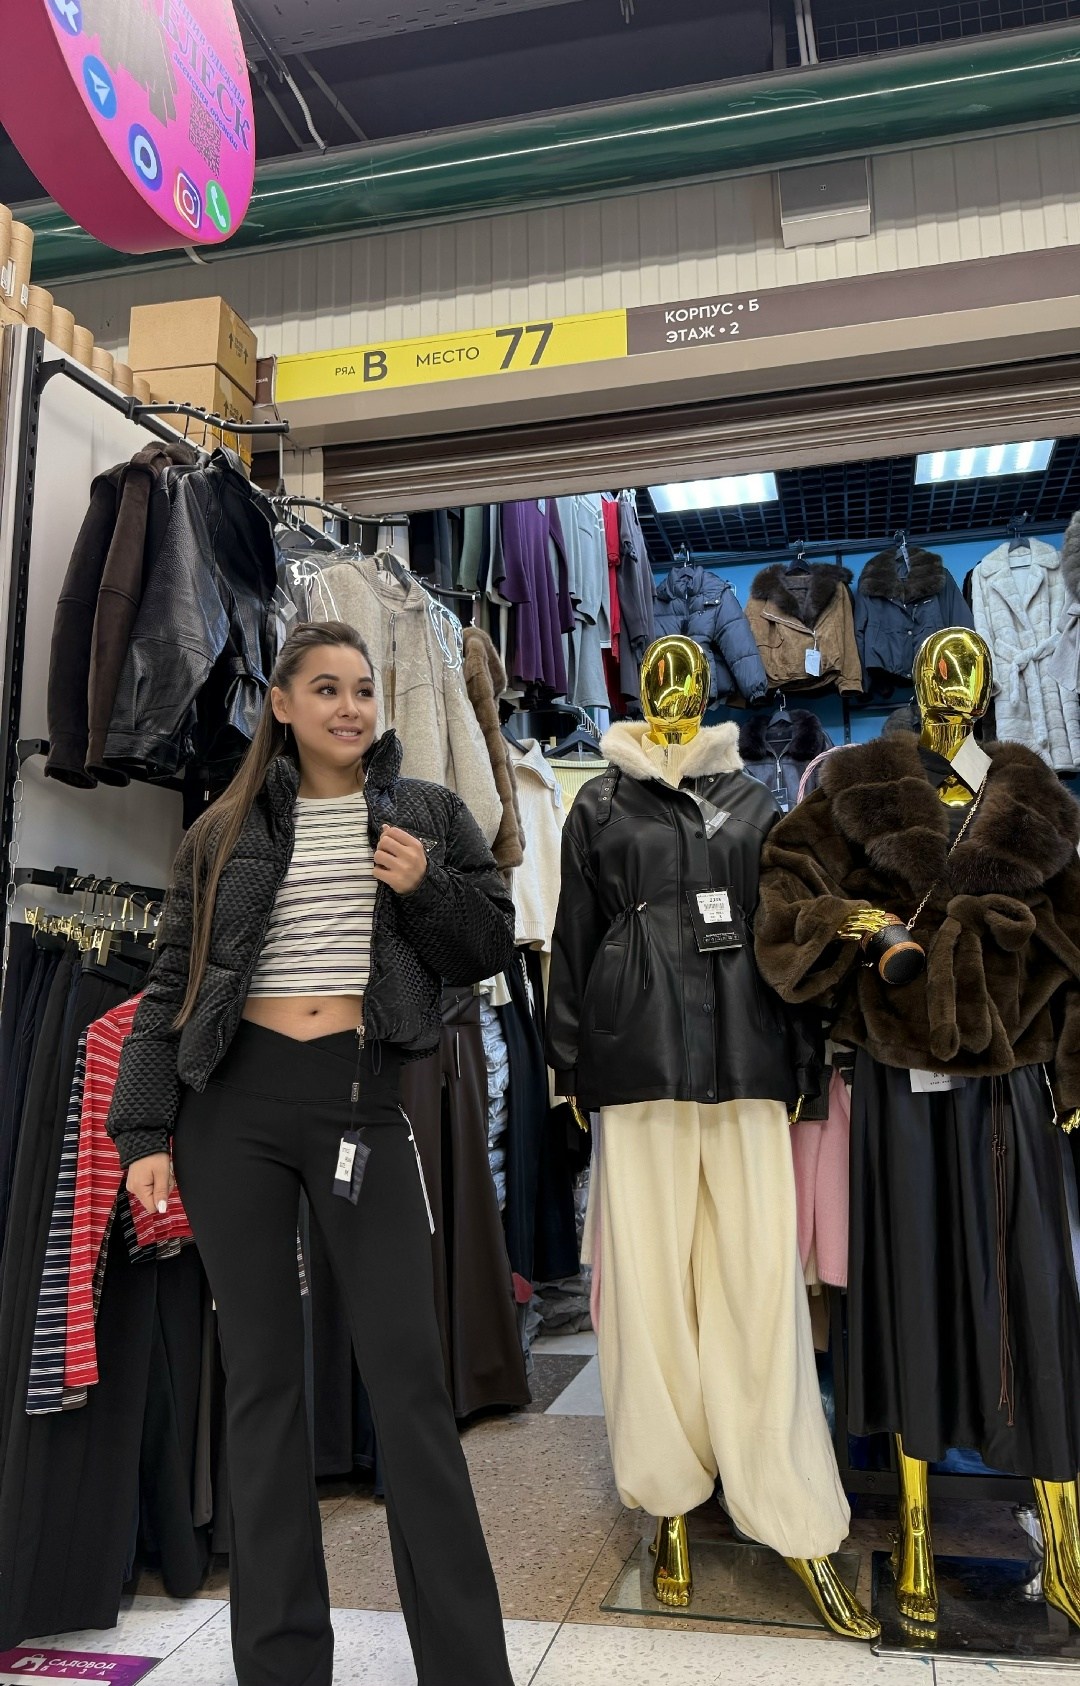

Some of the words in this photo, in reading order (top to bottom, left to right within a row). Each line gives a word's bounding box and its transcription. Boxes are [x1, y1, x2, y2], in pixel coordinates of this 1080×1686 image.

[160, 0, 250, 151] БЛЕСК
[664, 302, 734, 324] КОРПУС
[748, 298, 760, 312] Б
[665, 324, 716, 343] ЭТАЖ
[729, 321, 740, 335] 2
[335, 366, 356, 376] РЯД
[363, 350, 388, 383] В
[416, 346, 480, 367] МЕСТО
[495, 322, 554, 371] 77
[48, 1658, 116, 1669] САДОВОД
